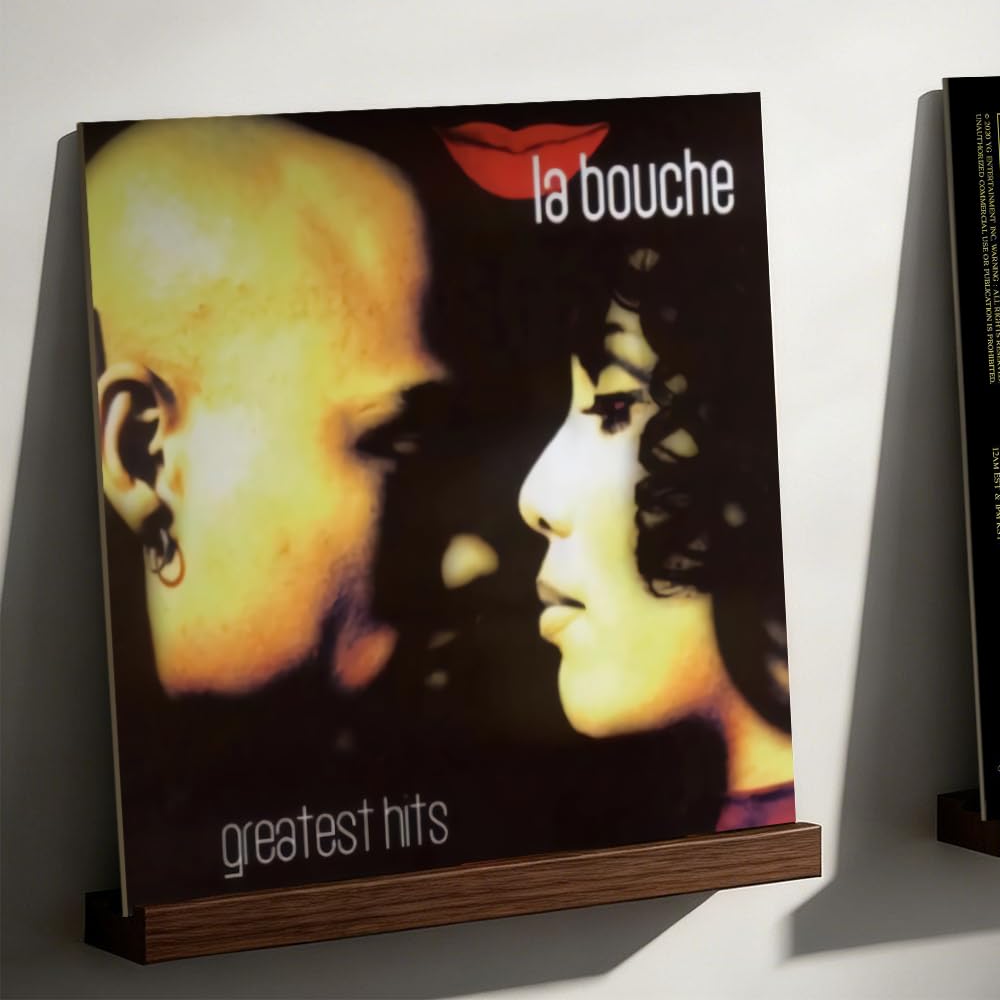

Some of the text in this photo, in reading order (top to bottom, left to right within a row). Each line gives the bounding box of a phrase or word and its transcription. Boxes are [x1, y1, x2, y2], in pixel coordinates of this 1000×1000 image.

[532, 147, 735, 224] la bouche
[992, 447, 1000, 470] 12AM
[993, 472, 1000, 490] EST
[221, 793, 449, 879] greatest hits
